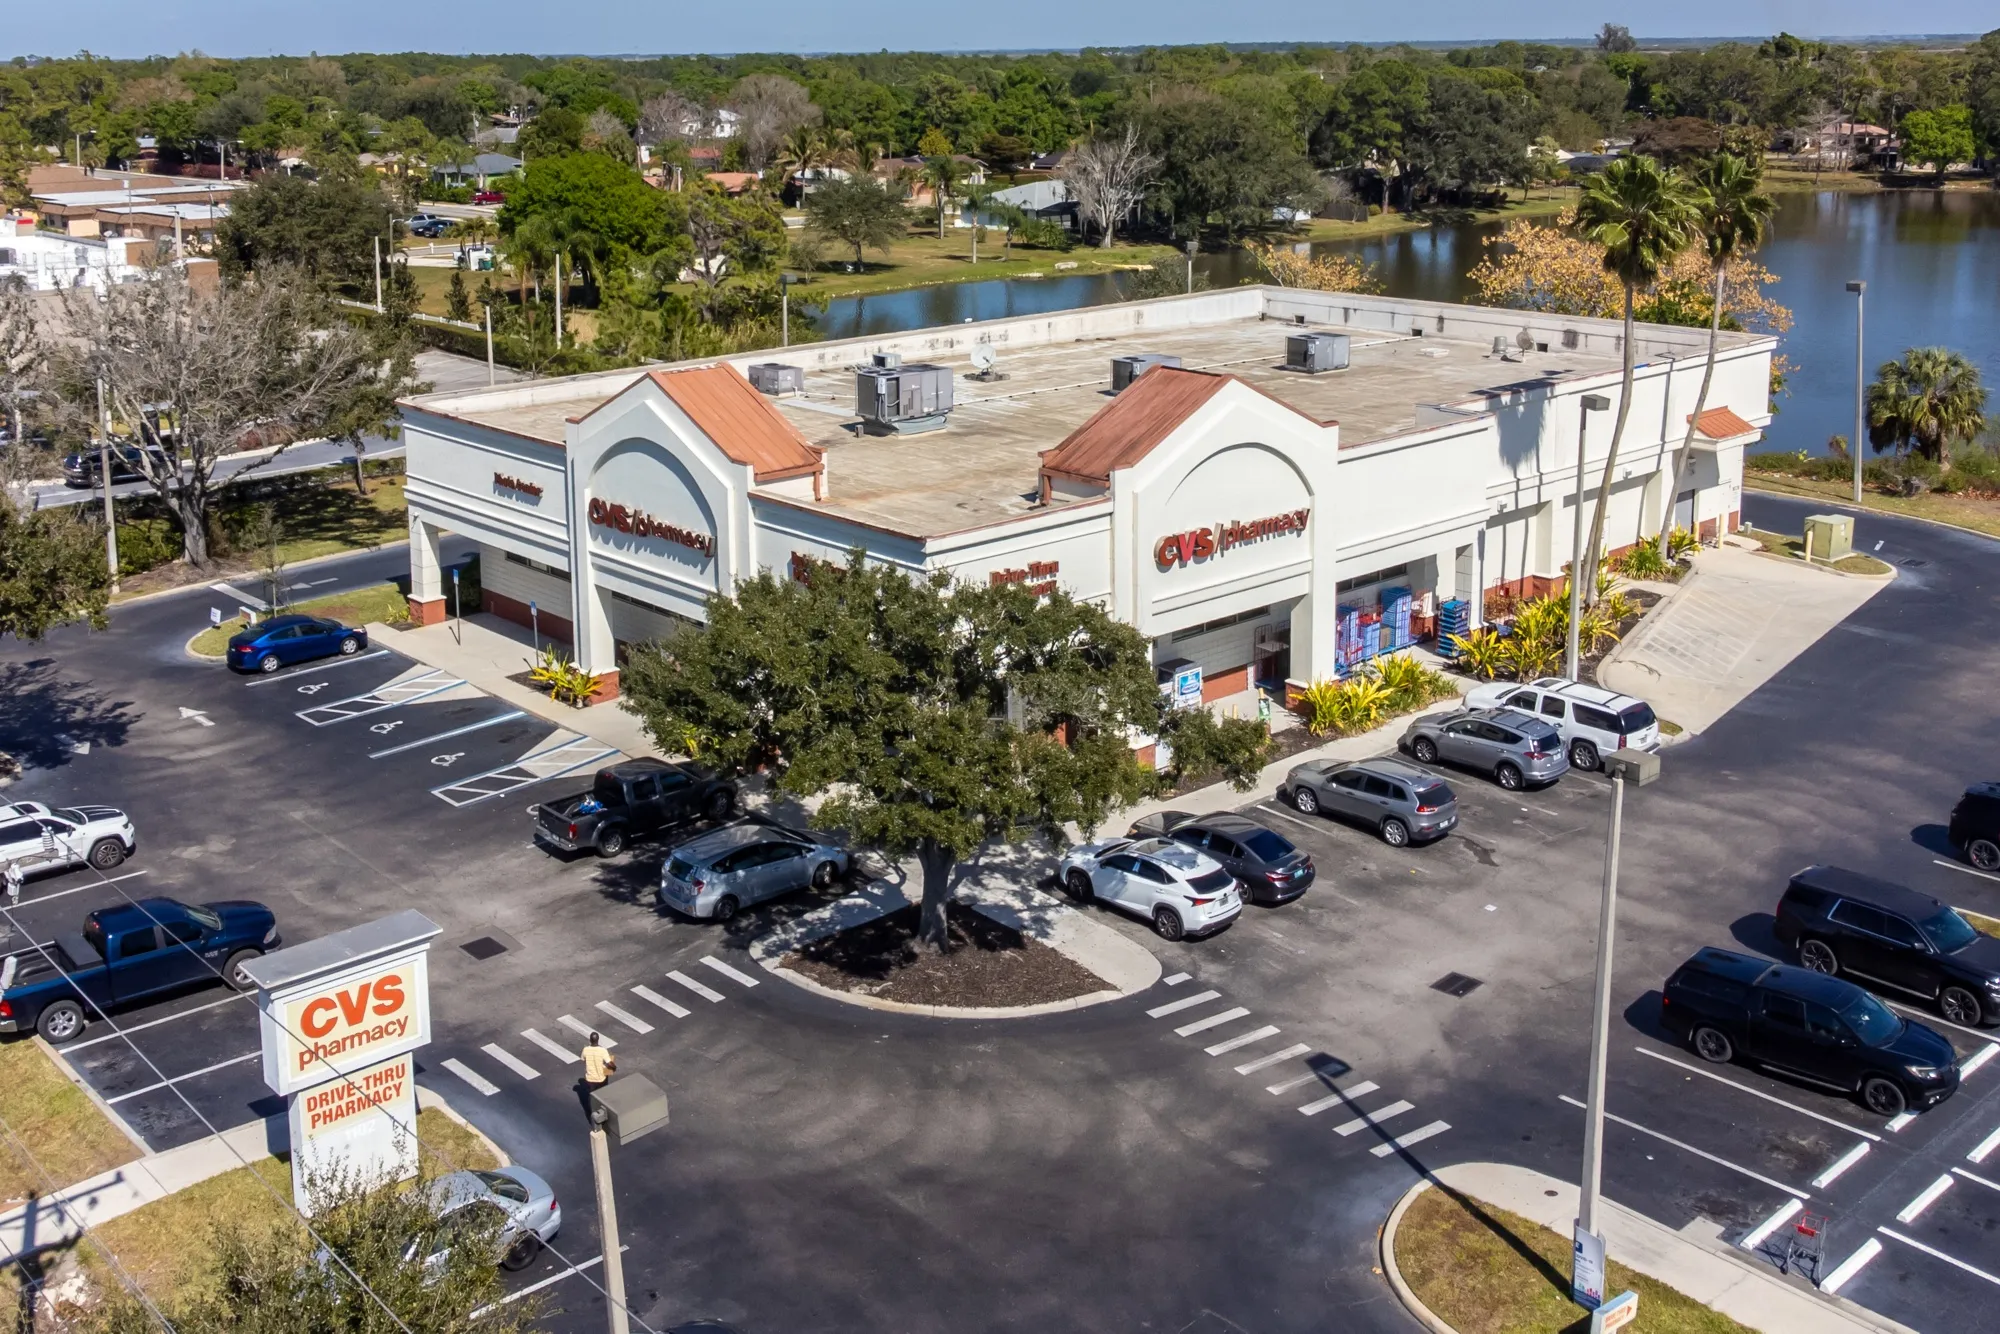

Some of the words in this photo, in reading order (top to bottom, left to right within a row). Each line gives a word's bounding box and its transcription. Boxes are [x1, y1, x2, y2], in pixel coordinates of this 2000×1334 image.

[1154, 508, 1310, 566] CVS/pharmacy
[300, 975, 405, 1038] CVS
[298, 1015, 409, 1071] pharmacy
[306, 1063, 406, 1113] DRIVE-THRU
[311, 1081, 403, 1129] PHARMACY
